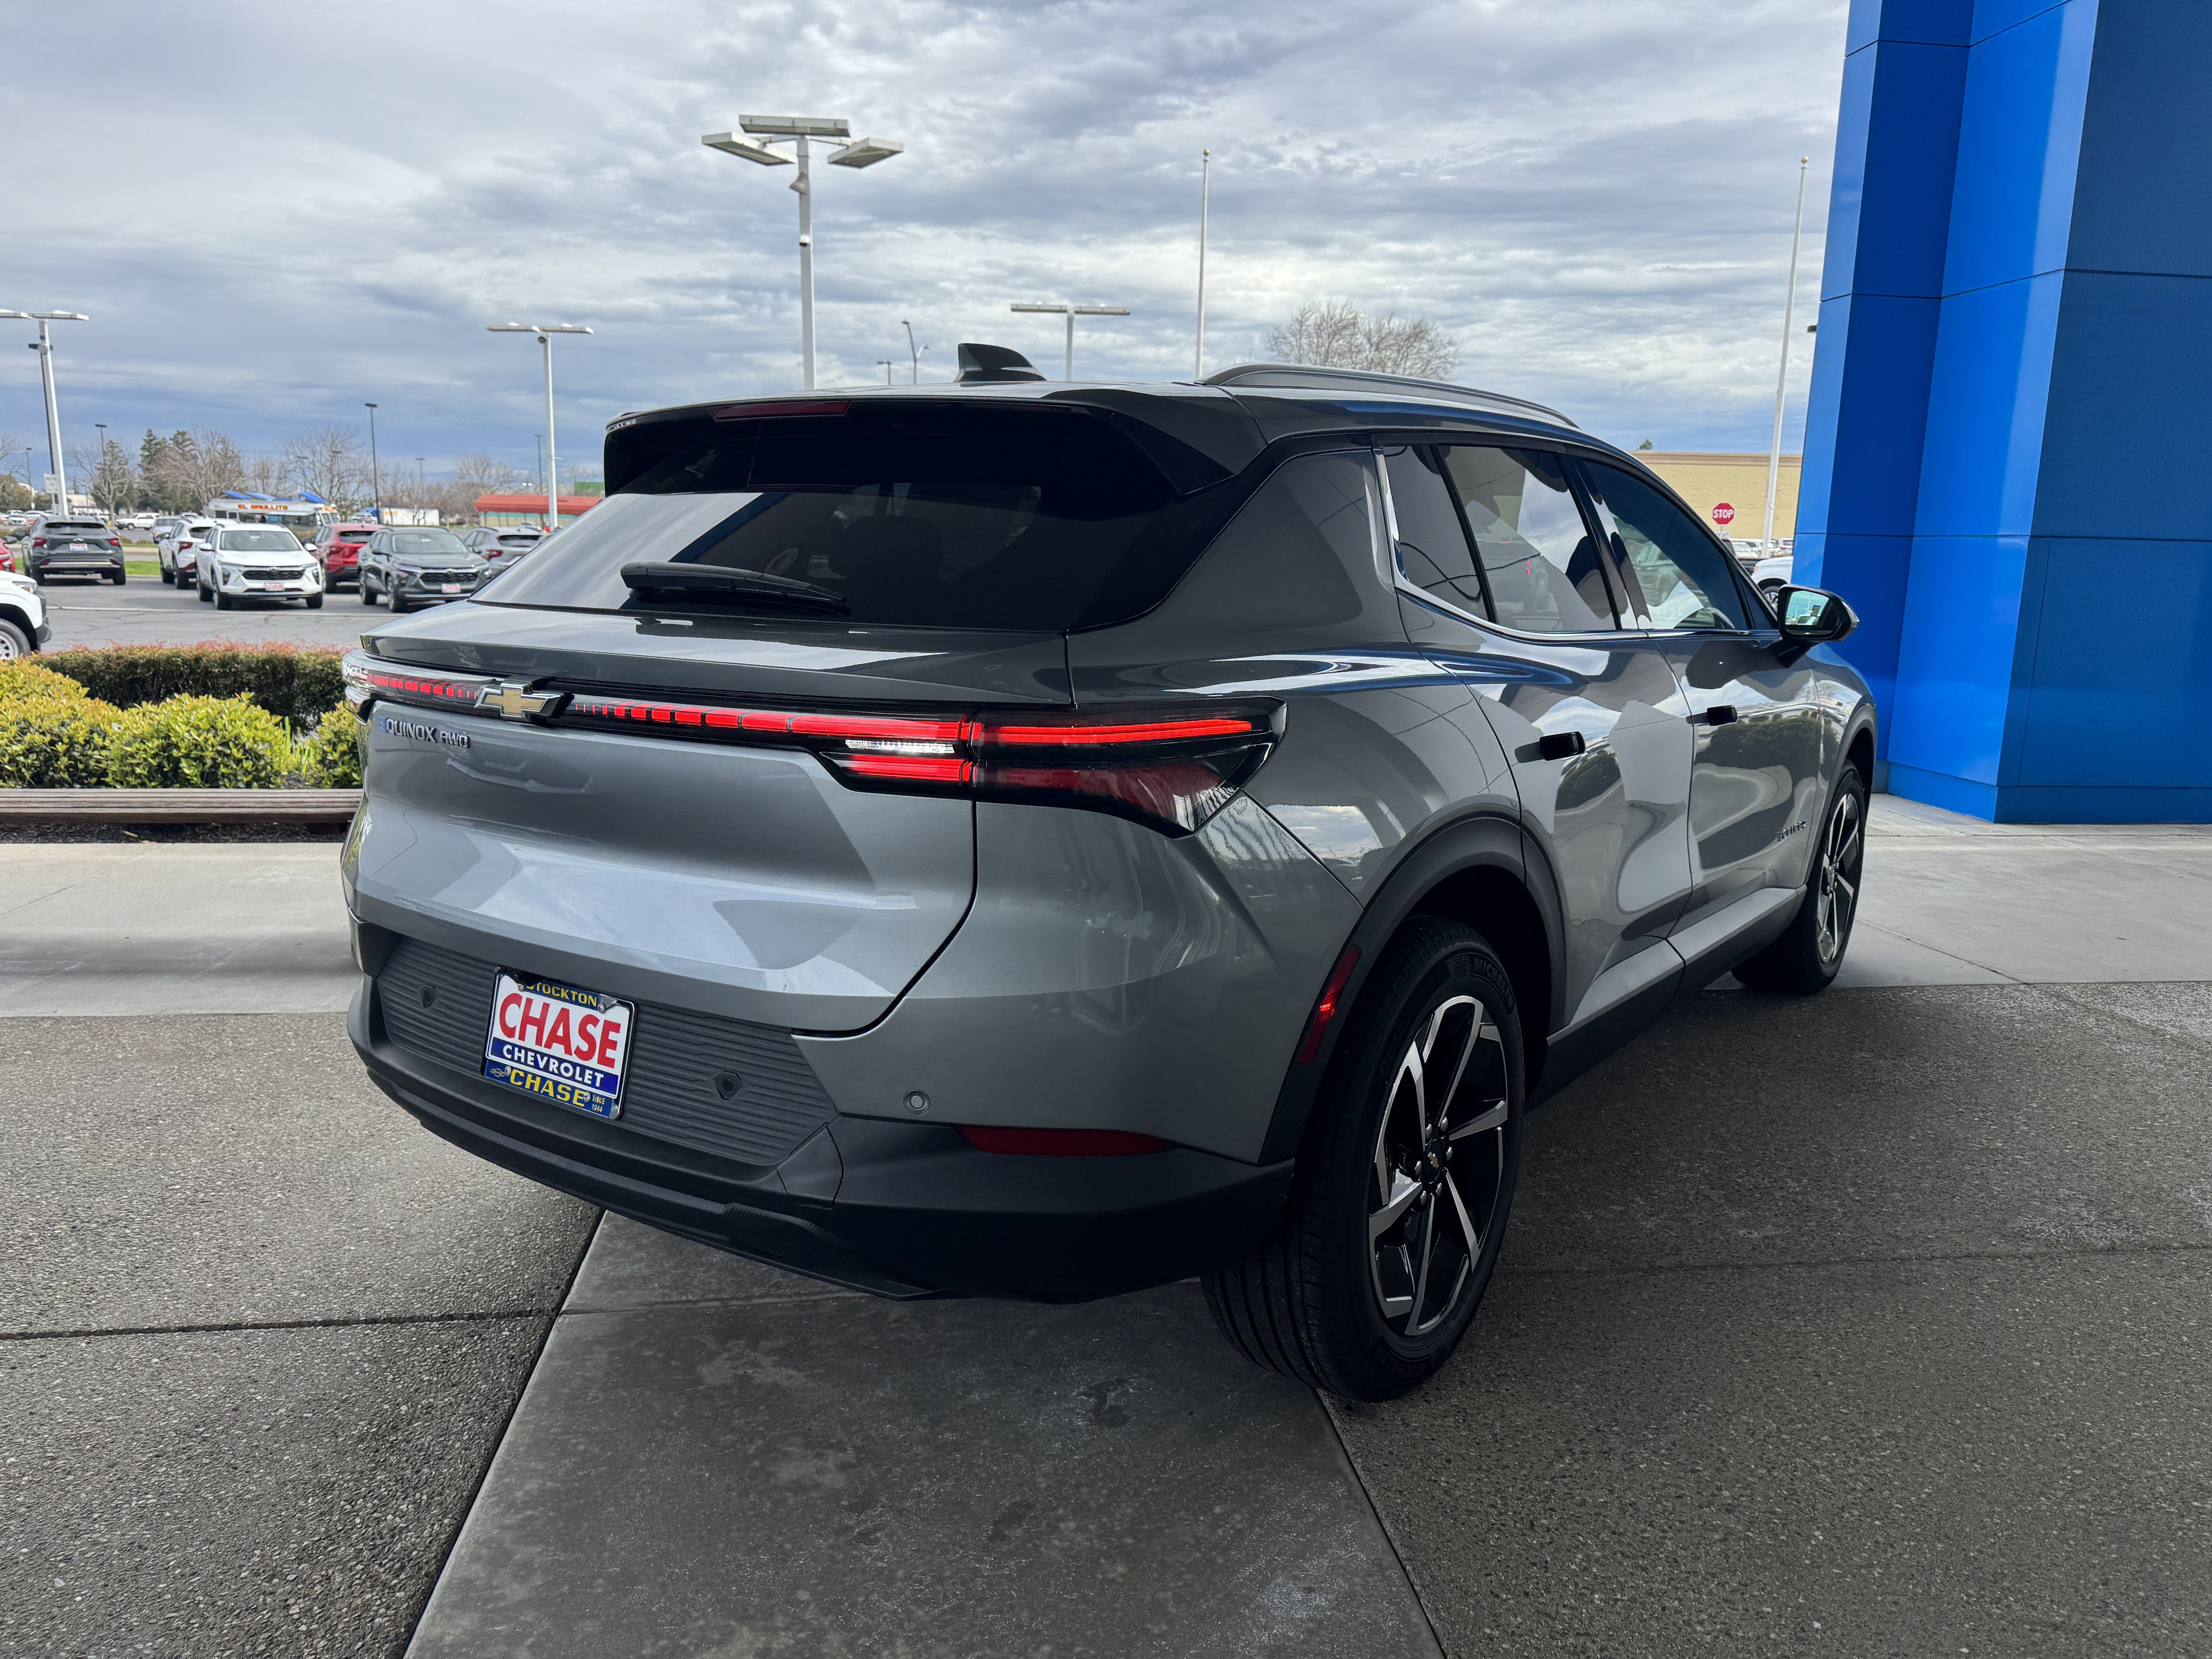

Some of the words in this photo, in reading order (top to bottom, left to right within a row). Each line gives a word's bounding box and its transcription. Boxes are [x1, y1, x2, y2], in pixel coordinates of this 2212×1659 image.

[1713, 509, 1734, 519] STOP
[440, 730, 470, 748] AWD
[1473, 958, 1514, 1008] MICHELIN
[499, 993, 622, 1069] CHASE
[503, 1044, 604, 1087] CHEVROLET
[510, 1069, 586, 1107] CHASE
[592, 1095, 606, 1105] SINCE
